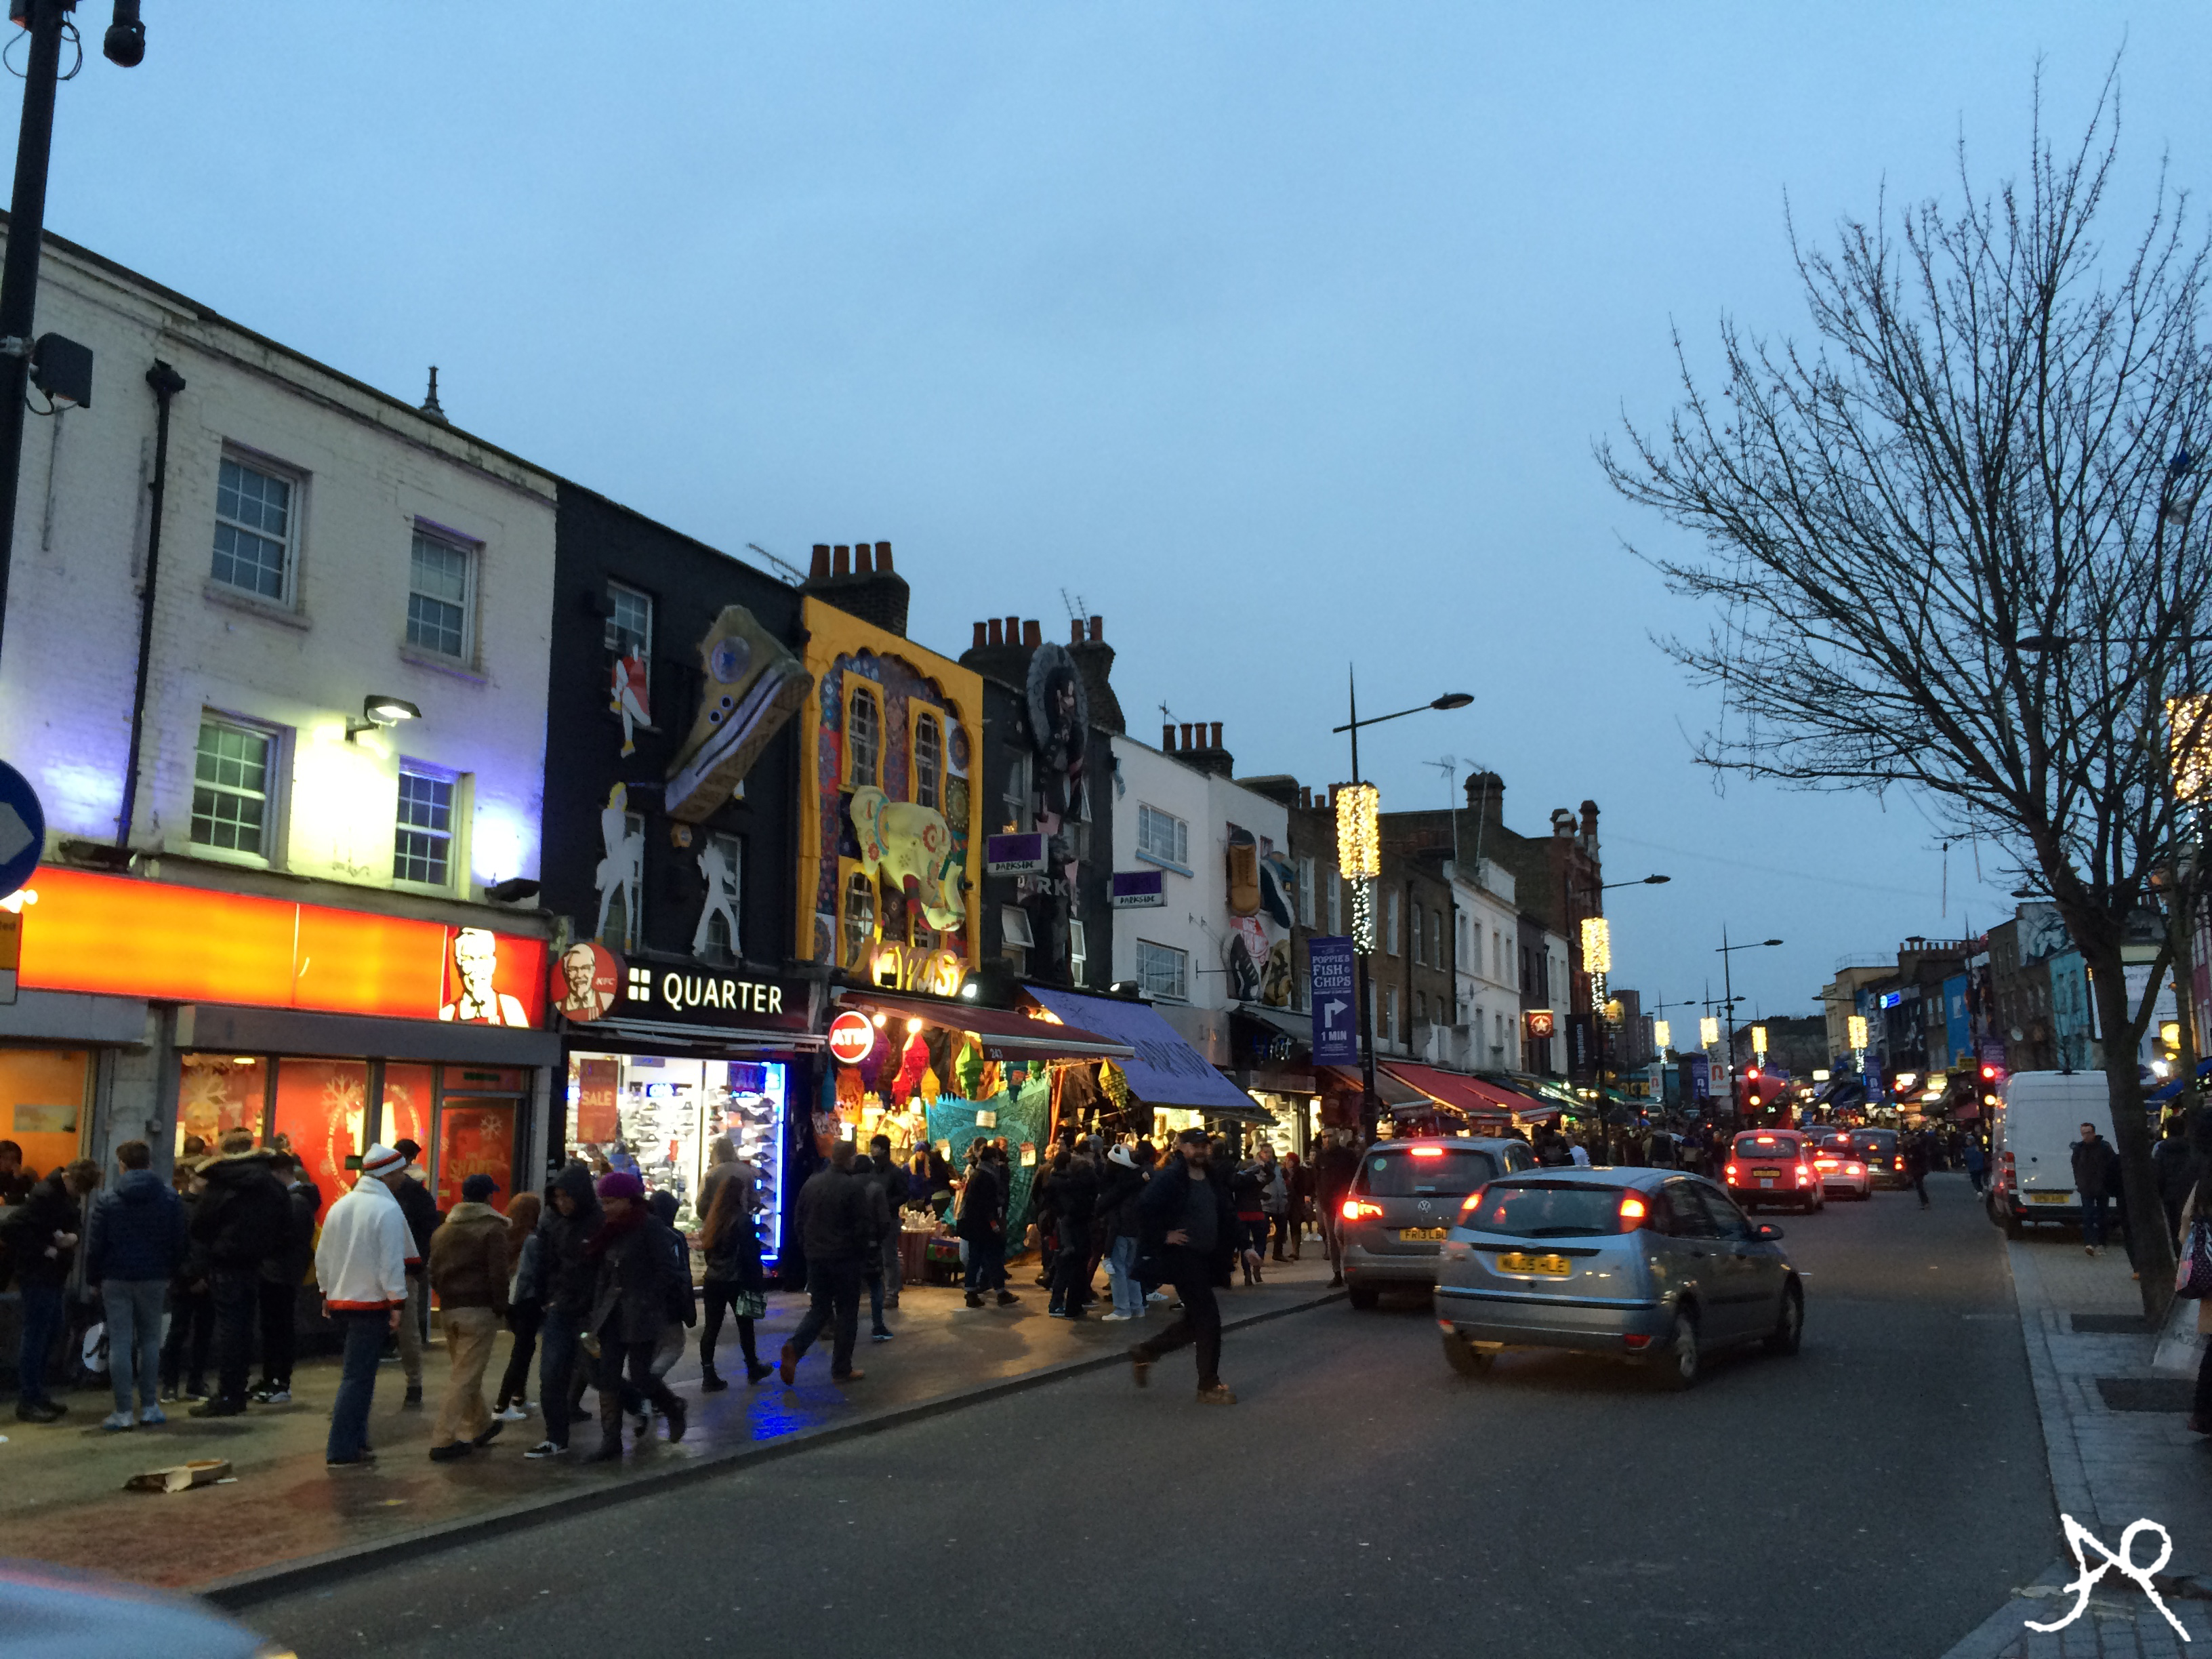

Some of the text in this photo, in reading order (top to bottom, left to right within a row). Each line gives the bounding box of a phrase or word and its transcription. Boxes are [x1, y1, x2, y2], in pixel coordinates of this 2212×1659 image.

[996, 861, 1033, 871] DARKSIDE
[1120, 895, 1155, 905] DARKSIDE
[1312, 954, 1350, 964] POPPIE'S
[1313, 964, 1343, 976] FISH
[595, 977, 615, 986] KFC
[1313, 976, 1351, 987] CHIPS
[663, 972, 783, 1015] QUARTER
[830, 1027, 869, 1046] ATM
[1321, 1031, 1347, 1041] 1 MIN
[989, 1048, 1003, 1059] 243
[581, 1091, 612, 1107] SALE
